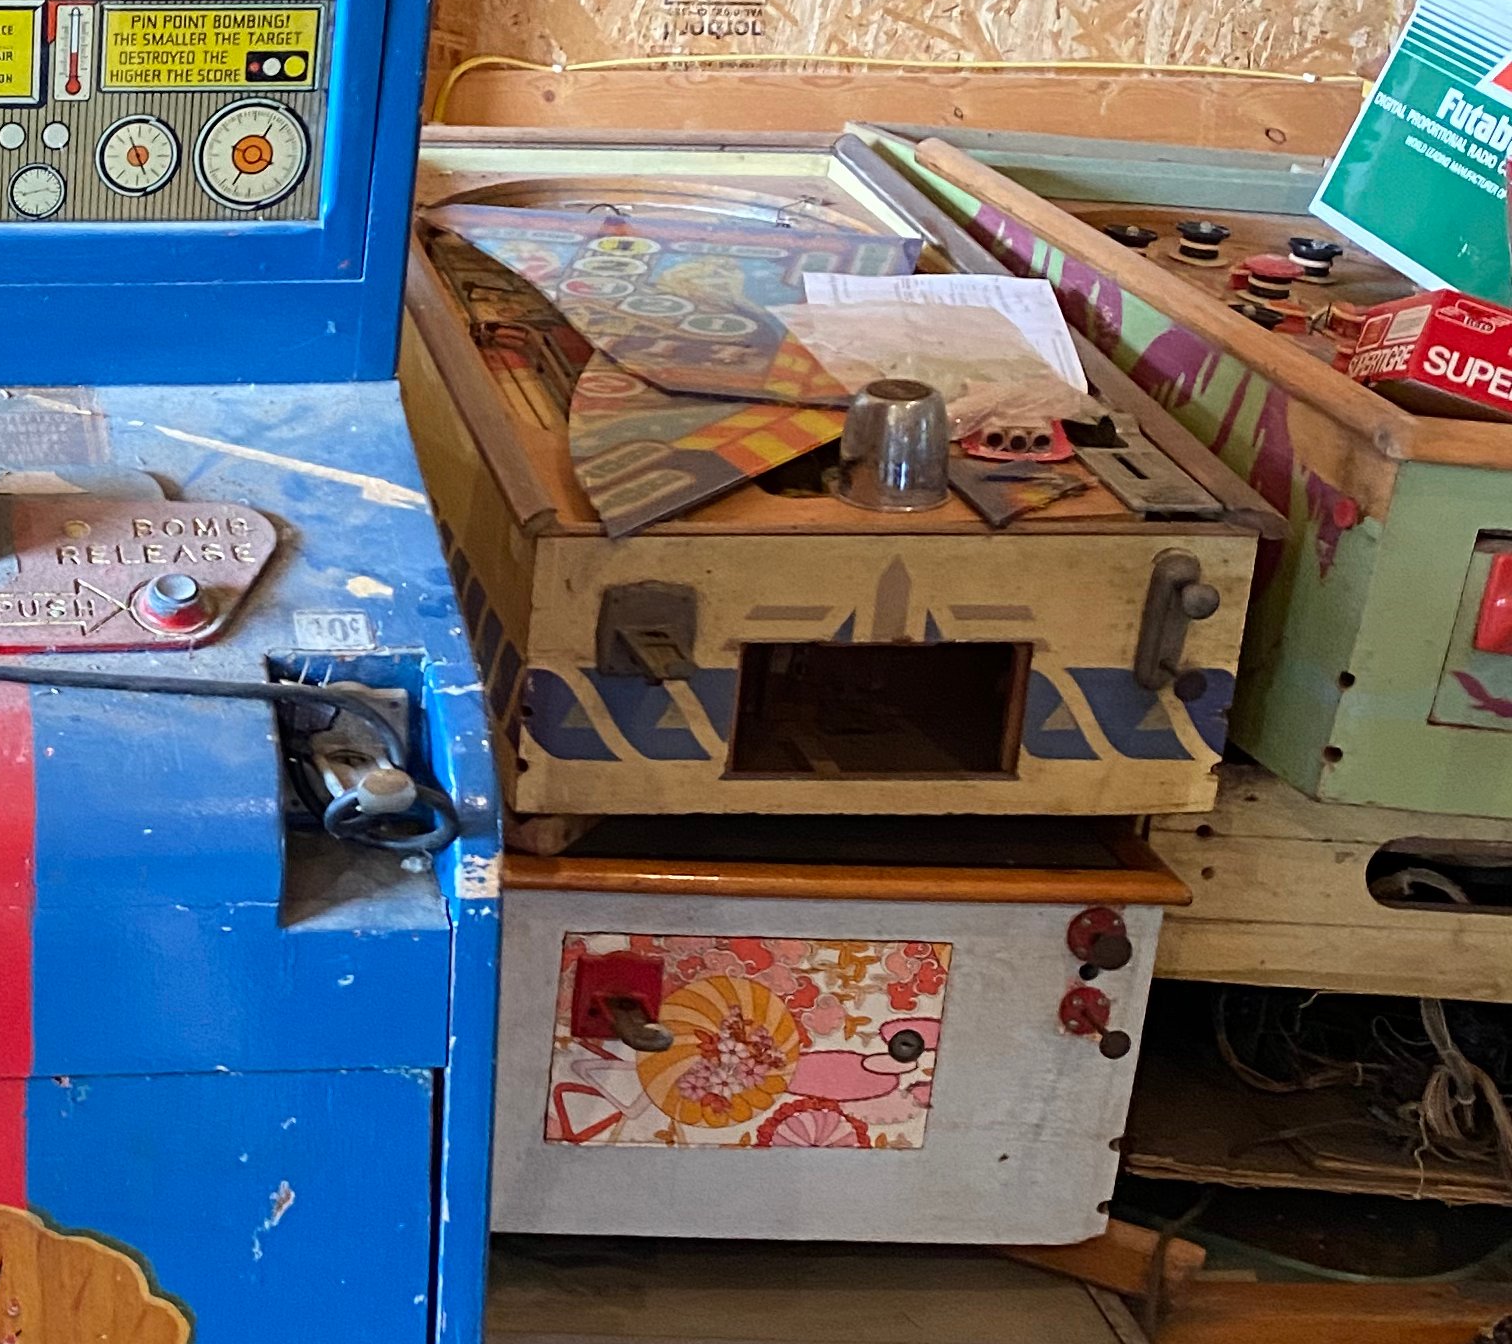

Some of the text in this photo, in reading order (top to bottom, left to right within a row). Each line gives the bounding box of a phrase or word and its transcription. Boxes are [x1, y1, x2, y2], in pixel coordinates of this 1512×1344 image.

[131, 14, 291, 30] PIN POINT BOMBING!
[113, 32, 303, 47] THE SMALLER THE TARGET
[119, 50, 229, 65] DESTROYED THE
[109, 69, 241, 83] HIGHER THE SCORE
[1374, 91, 1408, 120] DIGITAL
[1406, 108, 1468, 154] PROPORTIONAL
[1467, 143, 1498, 169] RADIO
[133, 517, 253, 540] BOMB
[55, 543, 256, 566] RELEASE
